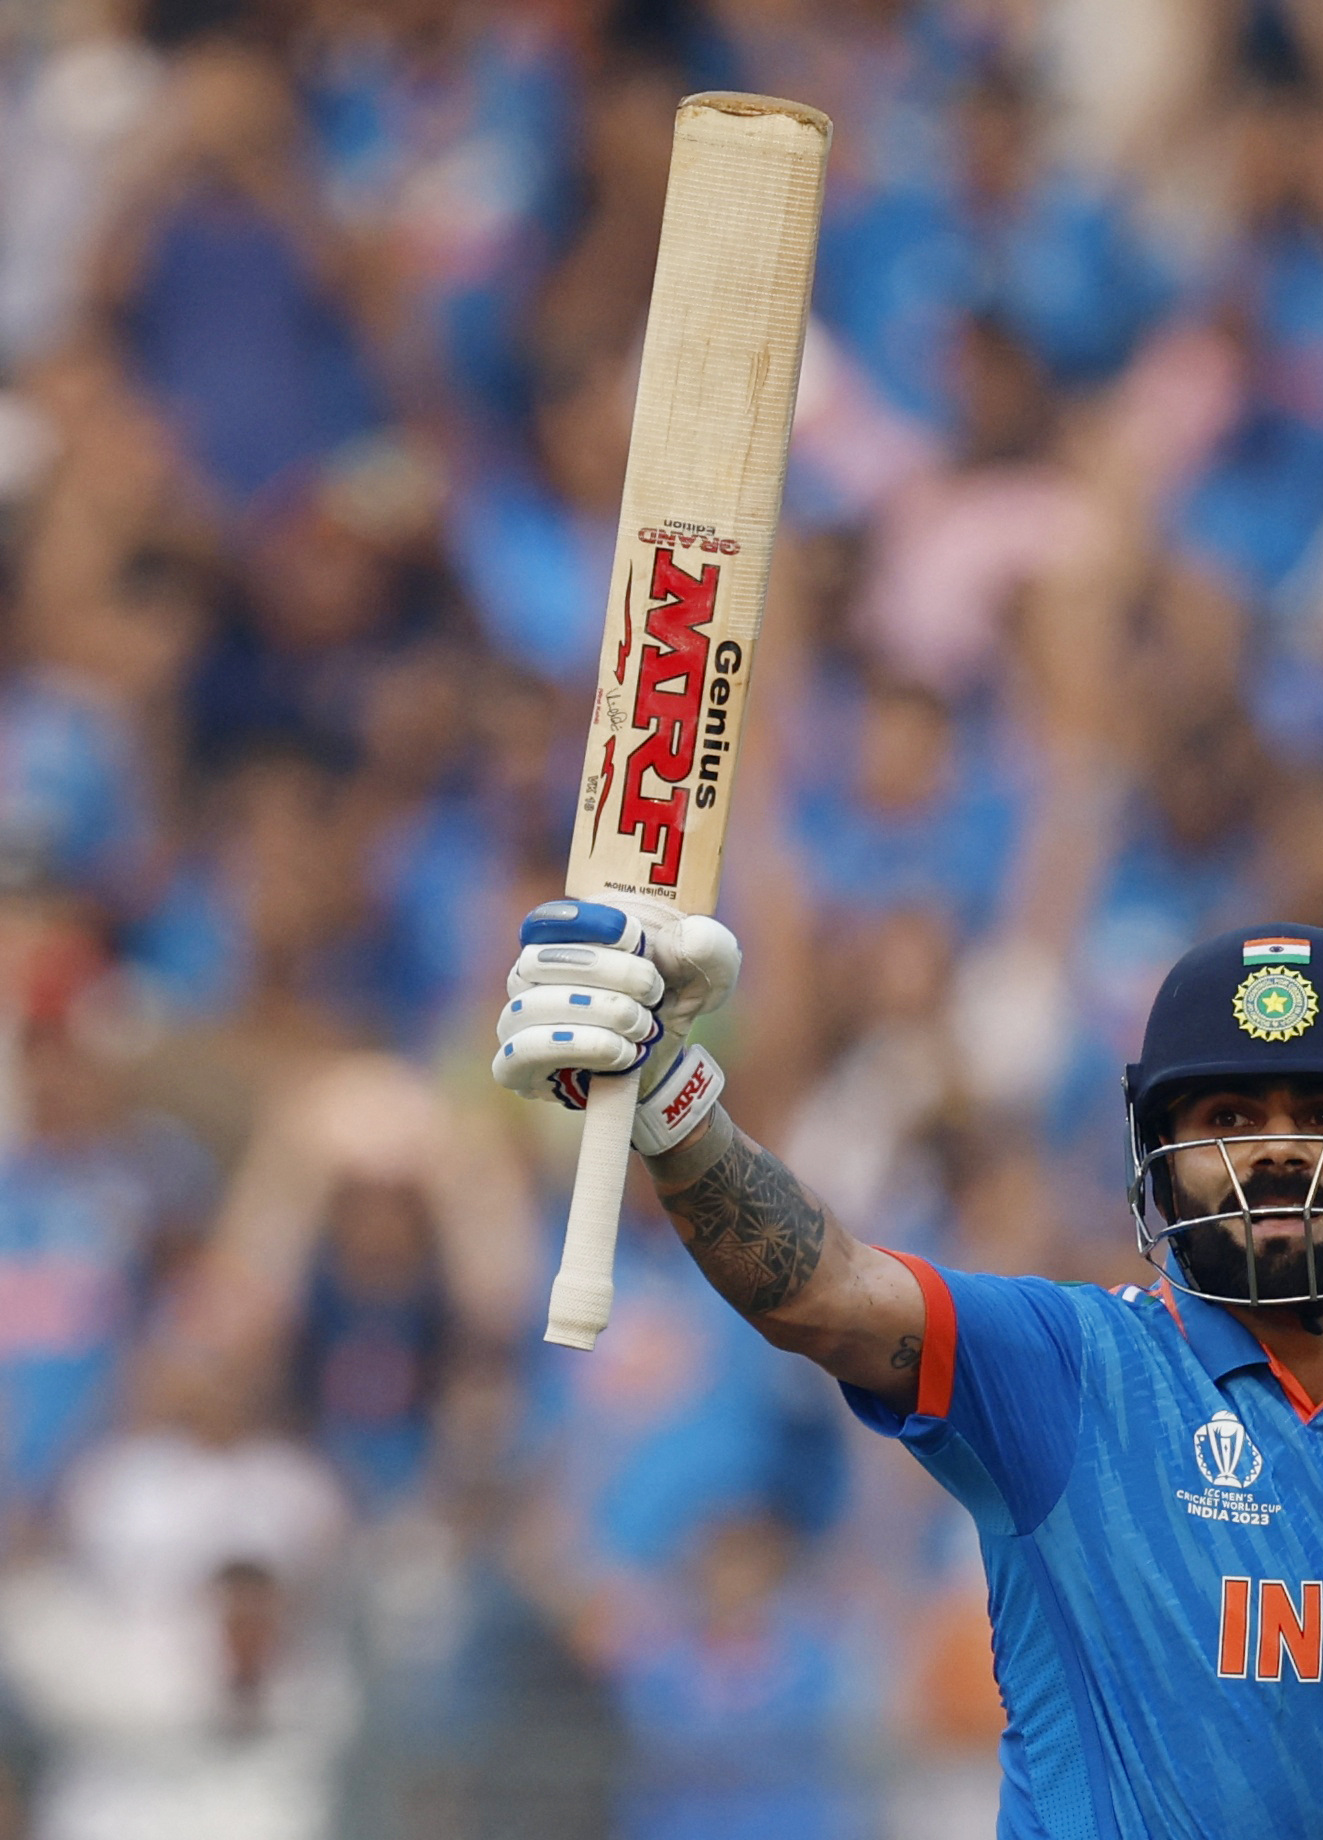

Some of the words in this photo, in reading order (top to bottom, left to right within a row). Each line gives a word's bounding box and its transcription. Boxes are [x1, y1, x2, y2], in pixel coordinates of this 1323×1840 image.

[663, 519, 717, 537] Edition
[637, 527, 742, 556] GRAND
[617, 547, 721, 887] MRF
[695, 640, 743, 810] Genius
[604, 881, 636, 894] Willow
[639, 886, 677, 900] English
[661, 1061, 705, 1124] MRF
[1176, 1489, 1220, 1507] CRICKET
[1222, 1500, 1259, 1512] WORLD
[1260, 1503, 1282, 1514] CUP
[1203, 1488, 1220, 1497] ICC
[1221, 1491, 1254, 1503] MEN'S
[1187, 1502, 1229, 1521] INDIA
[1231, 1511, 1270, 1526] 2023
